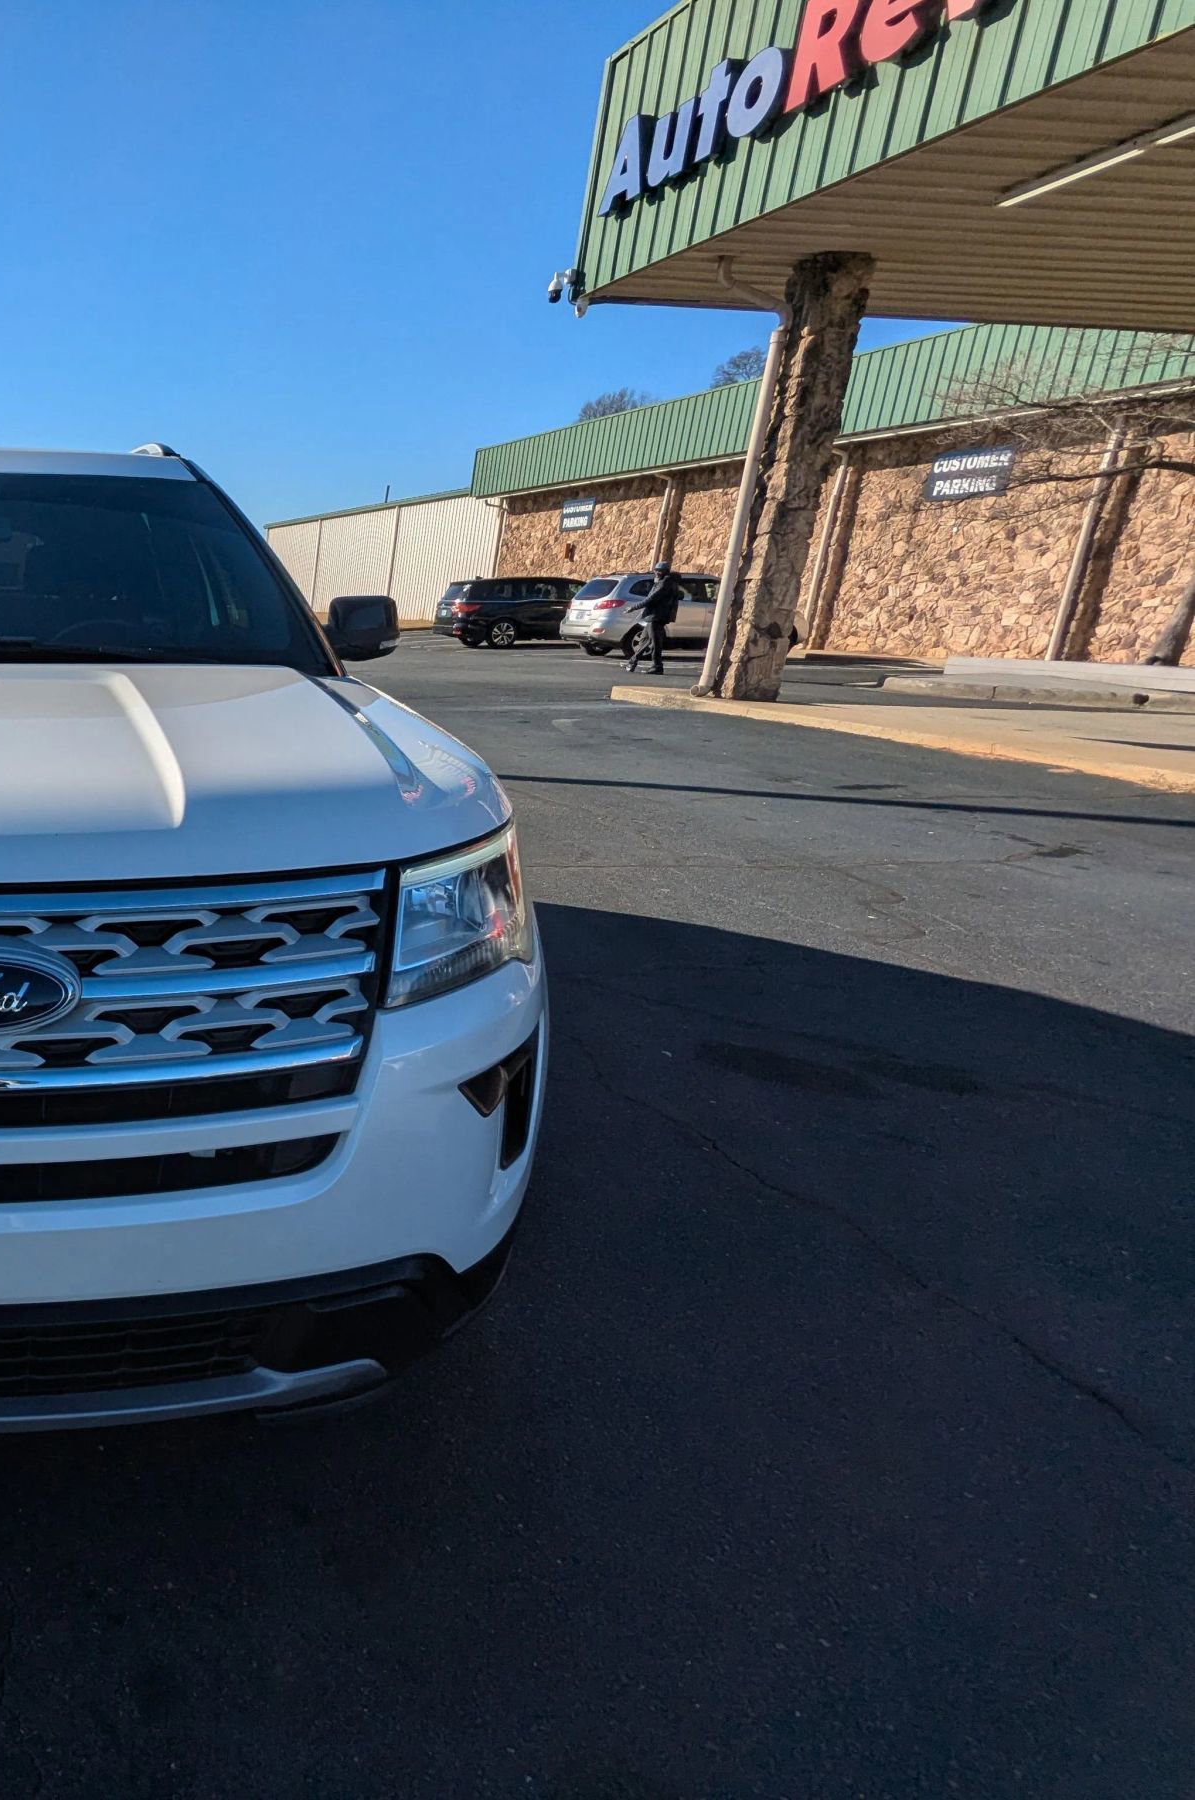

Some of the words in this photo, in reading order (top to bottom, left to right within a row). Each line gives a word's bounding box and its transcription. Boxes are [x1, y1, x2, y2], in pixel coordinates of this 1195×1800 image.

[933, 450, 1013, 473] CUSTOMER
[932, 475, 997, 496] PARKING
[562, 516, 588, 528] PARKING
